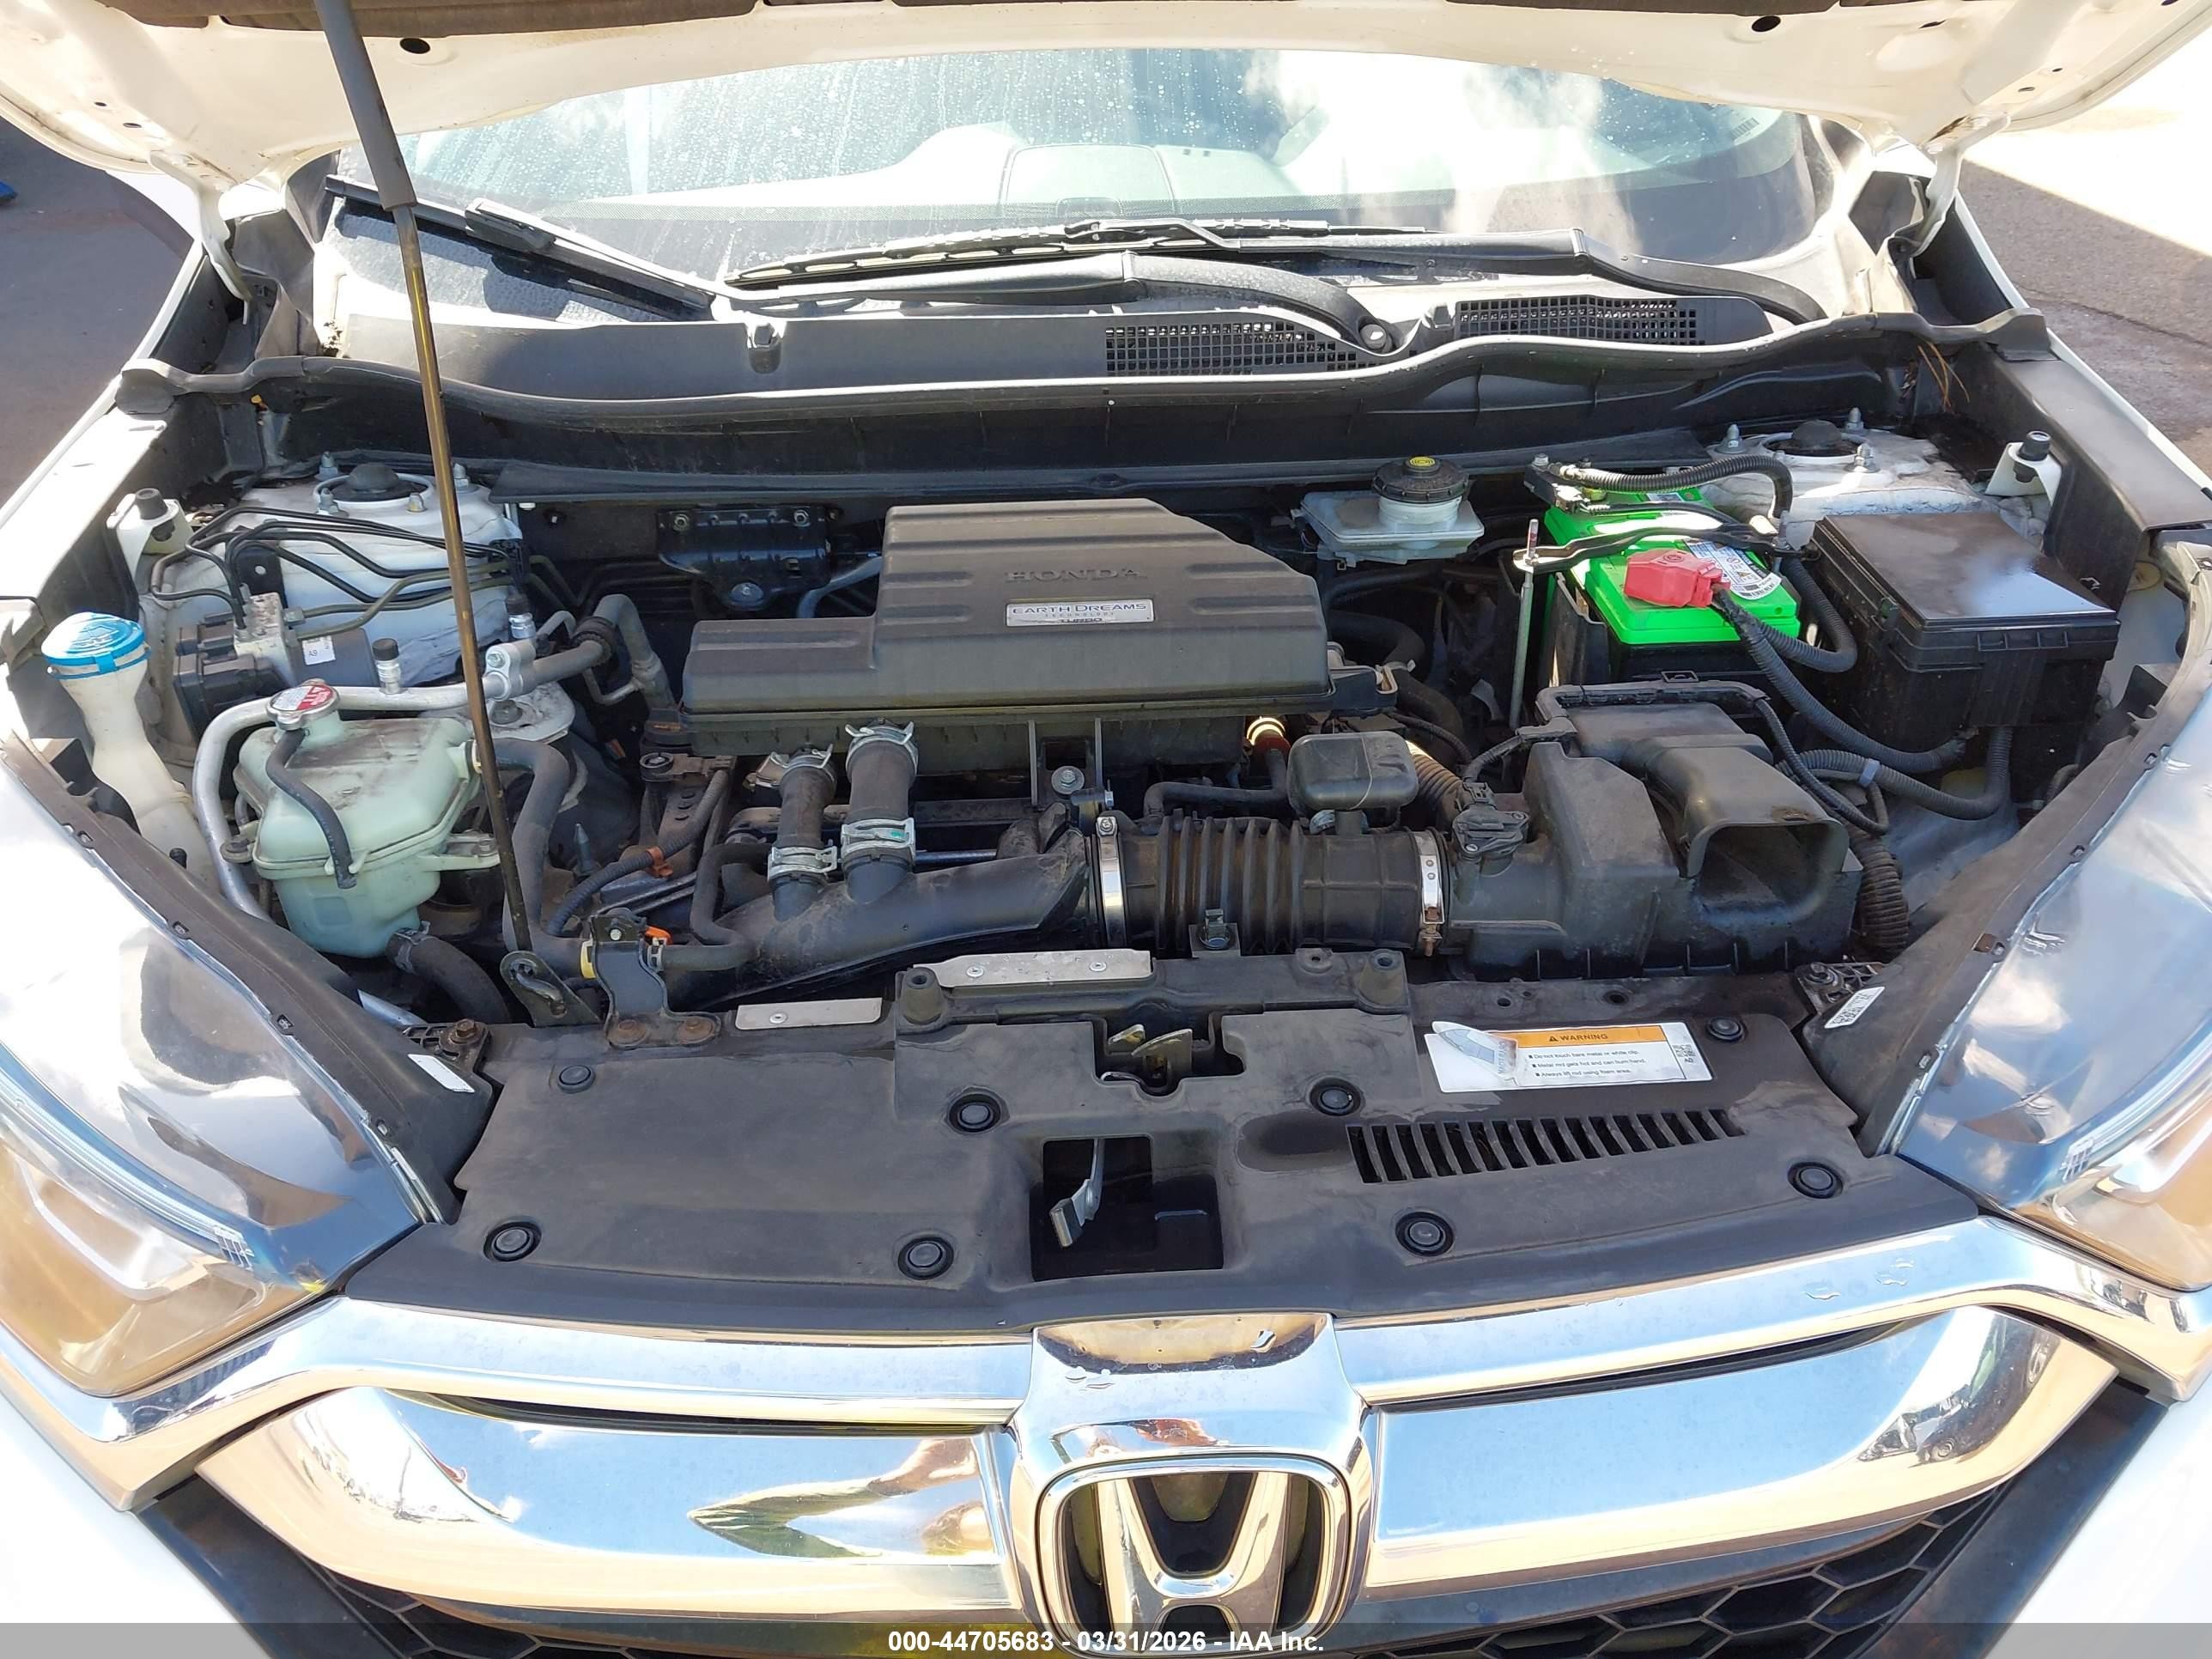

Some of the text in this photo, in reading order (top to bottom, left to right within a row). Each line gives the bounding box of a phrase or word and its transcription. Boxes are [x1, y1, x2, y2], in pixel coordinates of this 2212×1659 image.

[1004, 568, 1148, 582] HONDA
[1012, 604, 1146, 614] EARTH DREAMS
